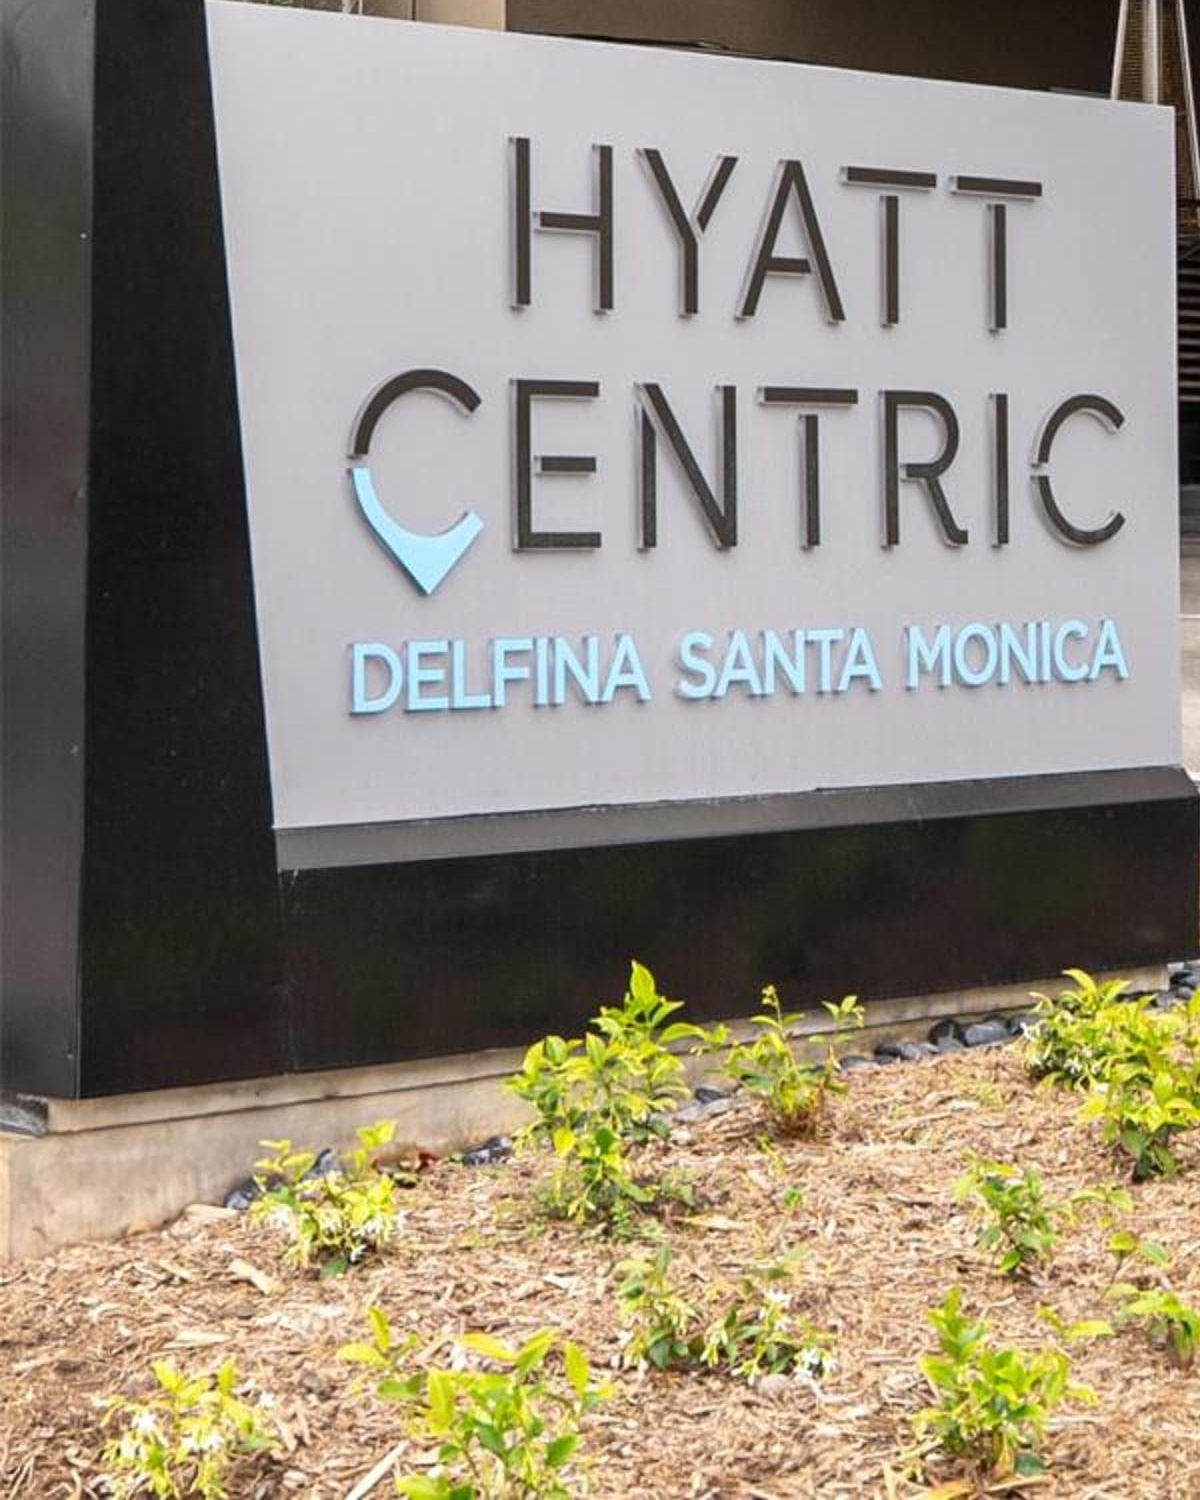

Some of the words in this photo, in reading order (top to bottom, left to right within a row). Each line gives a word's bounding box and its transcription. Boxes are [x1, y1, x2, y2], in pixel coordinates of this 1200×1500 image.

[508, 136, 1043, 331] HYATT
[348, 368, 1126, 595] CENTRIC
[349, 632, 651, 716] DELFINA
[676, 627, 882, 699] SANTA
[906, 617, 1129, 691] MONICA
